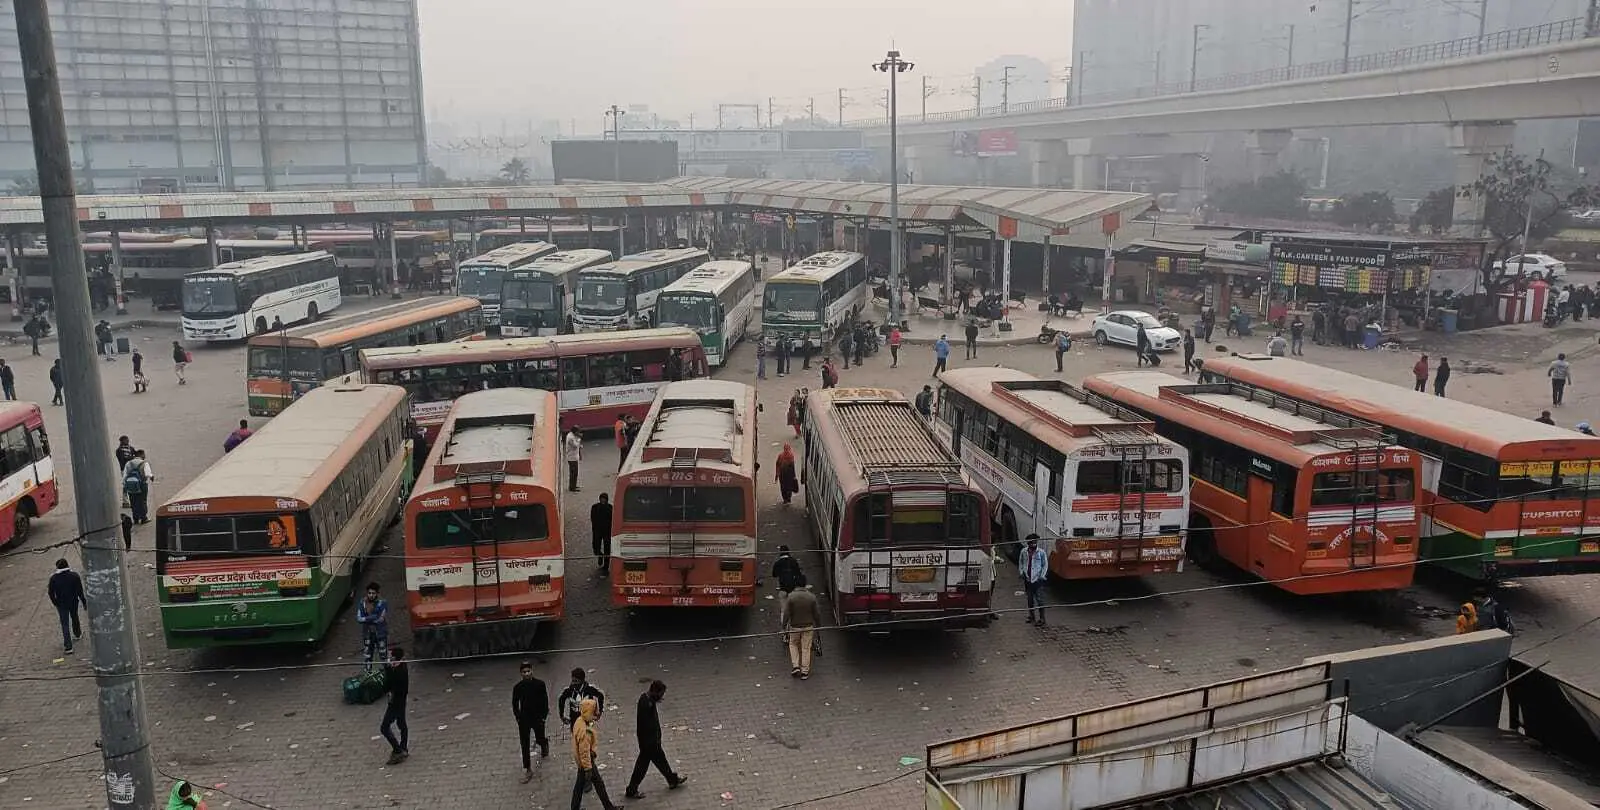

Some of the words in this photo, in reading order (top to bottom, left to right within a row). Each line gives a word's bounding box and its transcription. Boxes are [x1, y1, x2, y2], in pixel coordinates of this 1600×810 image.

[1296, 252, 1328, 261] CANTEEN
[1355, 256, 1376, 265] FOOD
[227, 572, 247, 582] प्रदेश
[248, 570, 277, 581] परिवहन
